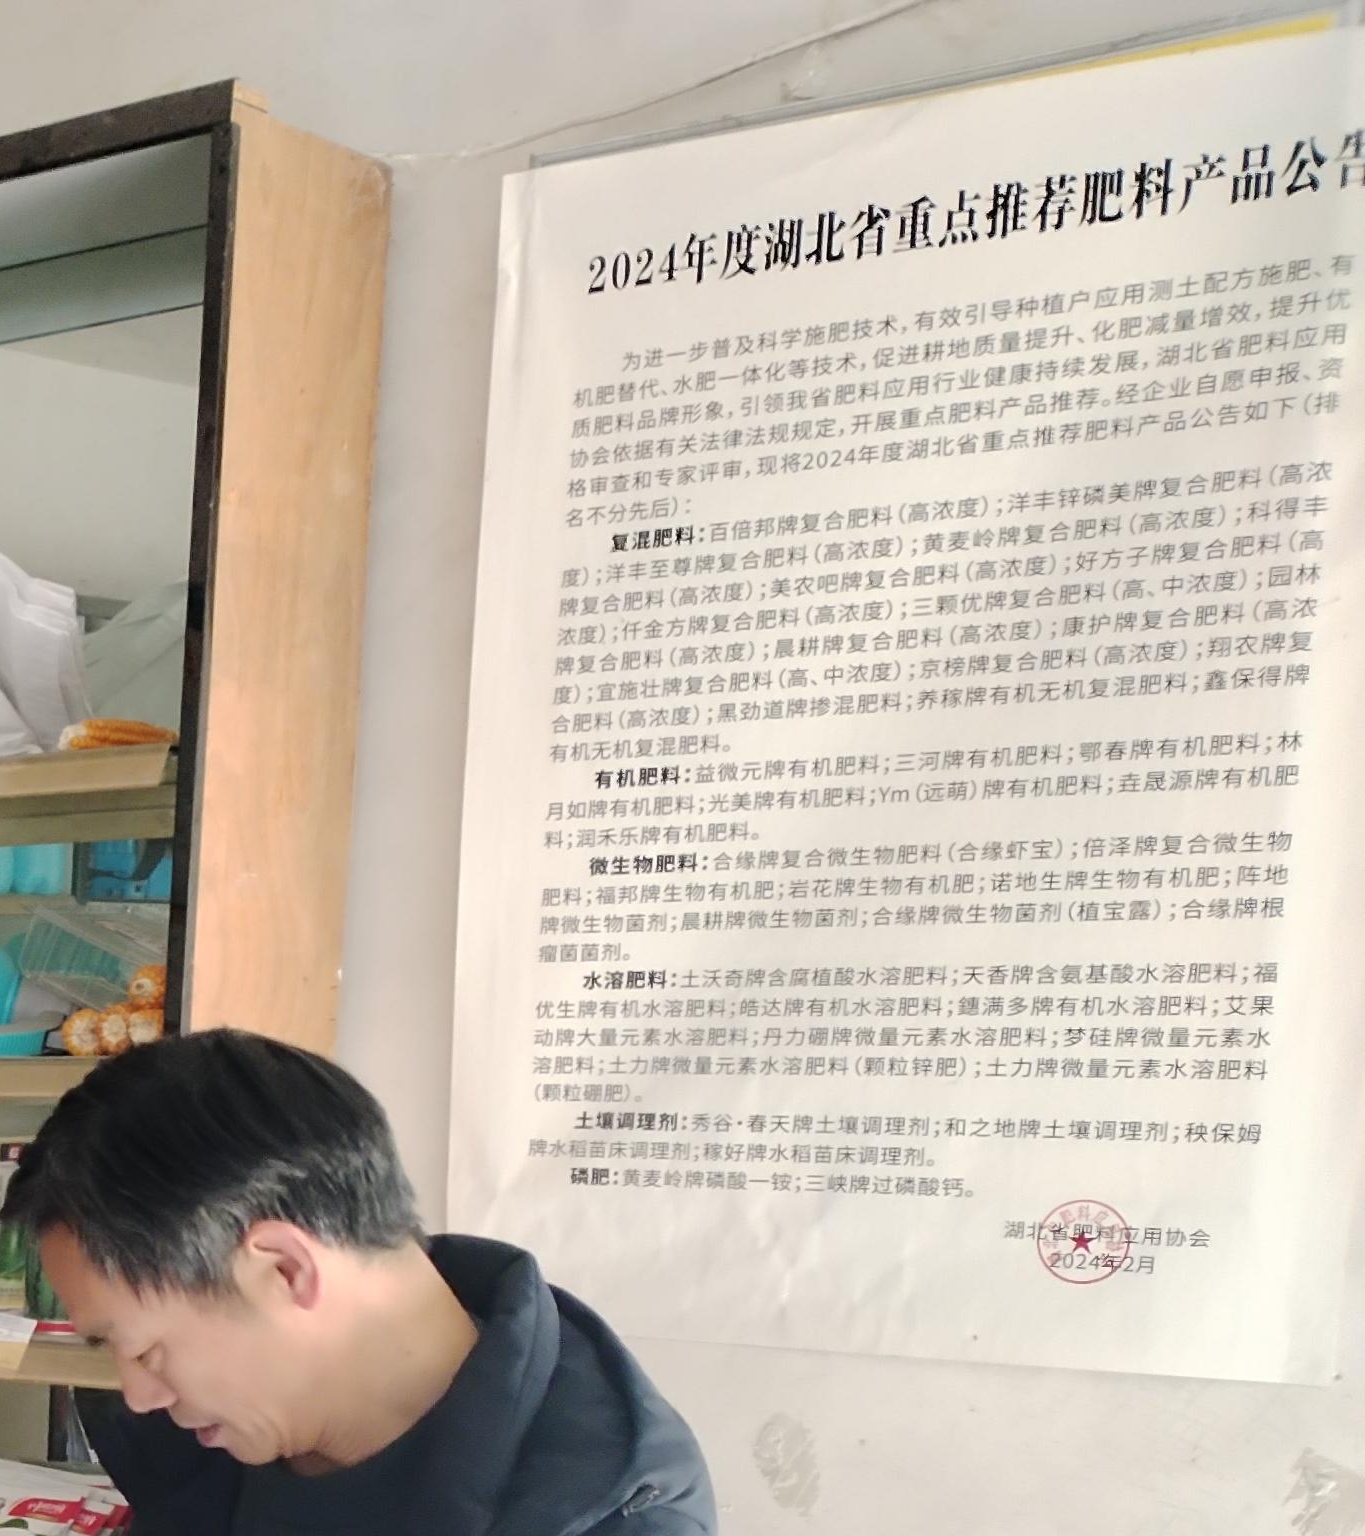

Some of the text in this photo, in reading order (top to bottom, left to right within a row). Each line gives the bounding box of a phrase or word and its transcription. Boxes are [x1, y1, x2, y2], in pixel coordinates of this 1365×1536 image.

[588, 128, 1365, 295] 2024年度湖北省重点推荐肥料产品公告
